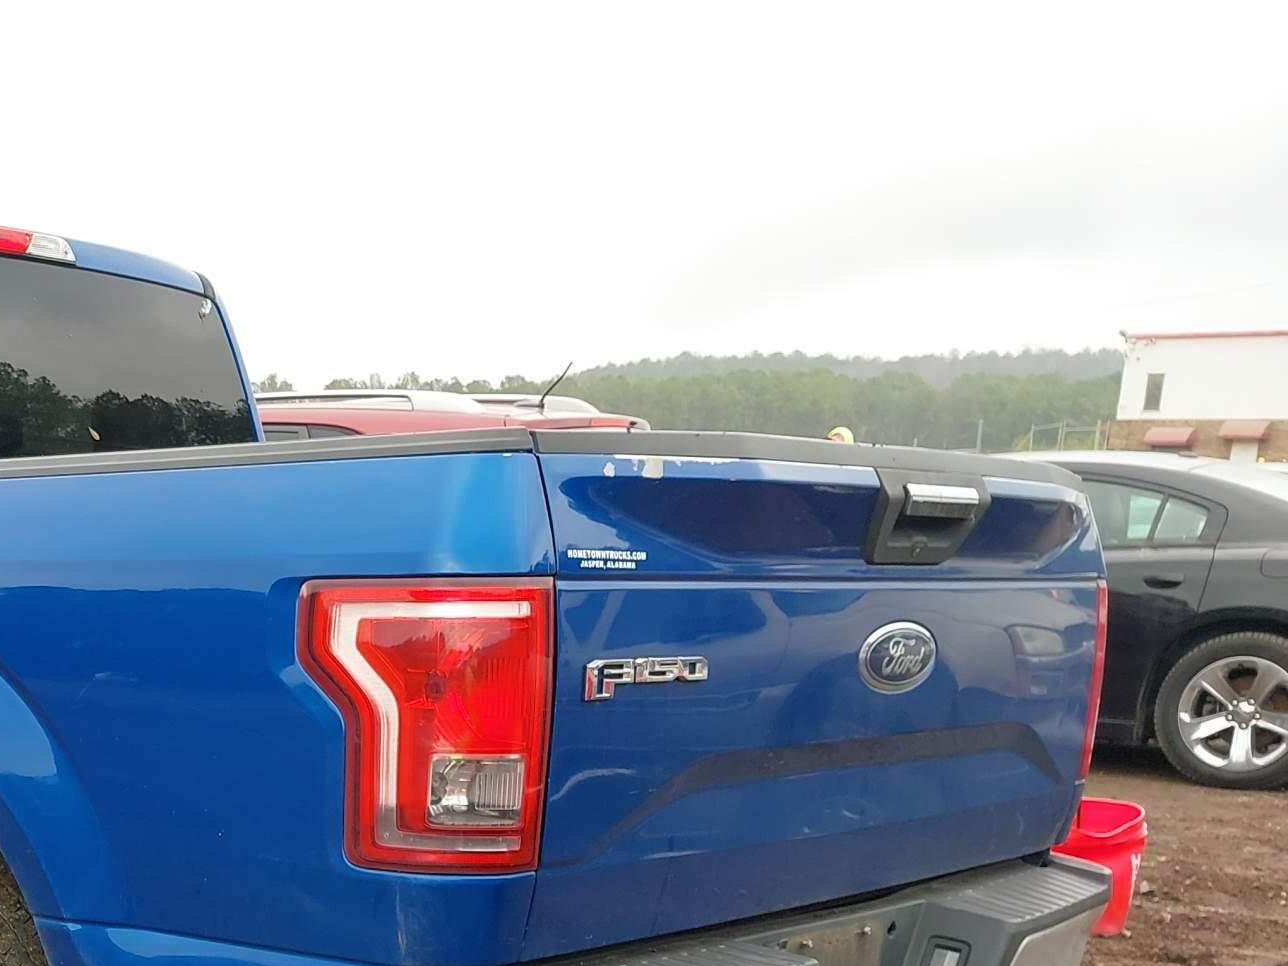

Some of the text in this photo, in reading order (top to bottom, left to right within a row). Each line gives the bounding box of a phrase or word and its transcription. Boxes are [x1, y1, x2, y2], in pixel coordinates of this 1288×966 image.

[567, 549, 647, 560] HOMETOWNTRUCKS.COM
[606, 560, 636, 569] ALABAMA
[881, 637, 925, 676] Ford
